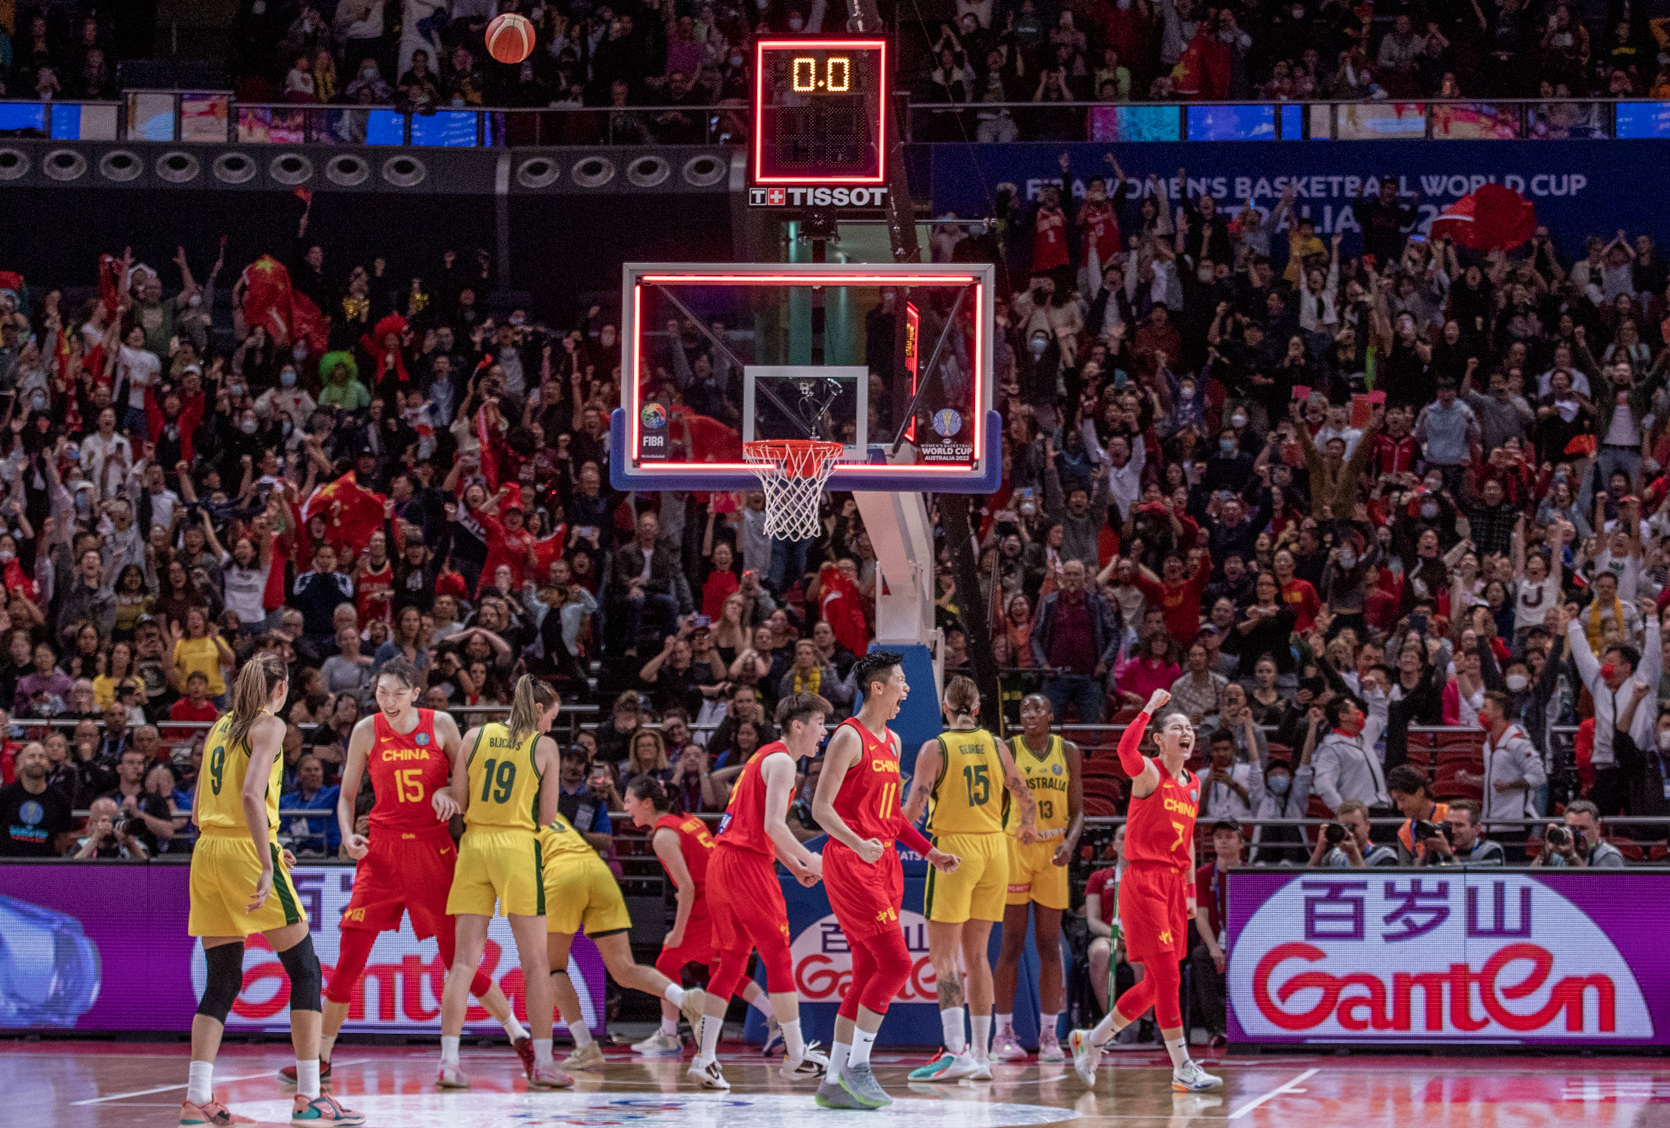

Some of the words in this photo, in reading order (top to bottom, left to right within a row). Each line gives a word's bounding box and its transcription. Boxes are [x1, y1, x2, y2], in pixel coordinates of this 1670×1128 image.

[793, 57, 850, 92] 0.0
[787, 187, 888, 206] TISSOT
[1234, 175, 1414, 199] BASKETBAL
[1420, 173, 1526, 197] WORD
[1530, 173, 1588, 197] CUP
[642, 436, 664, 447] FIBA
[922, 447, 953, 455] WORLD
[955, 447, 973, 455] CUP
[382, 748, 430, 762] CHINA
[958, 744, 985, 755] GEORGE
[210, 745, 225, 796] 9
[481, 758, 517, 804] 19
[963, 764, 990, 807] 15
[394, 769, 424, 803] 15
[879, 782, 897, 819] 11
[1038, 800, 1053, 820] 13
[1163, 798, 1195, 819] CHINA
[1170, 821, 1185, 852] 7
[1302, 879, 1532, 943] 百岁山
[820, 923, 931, 953] 百山
